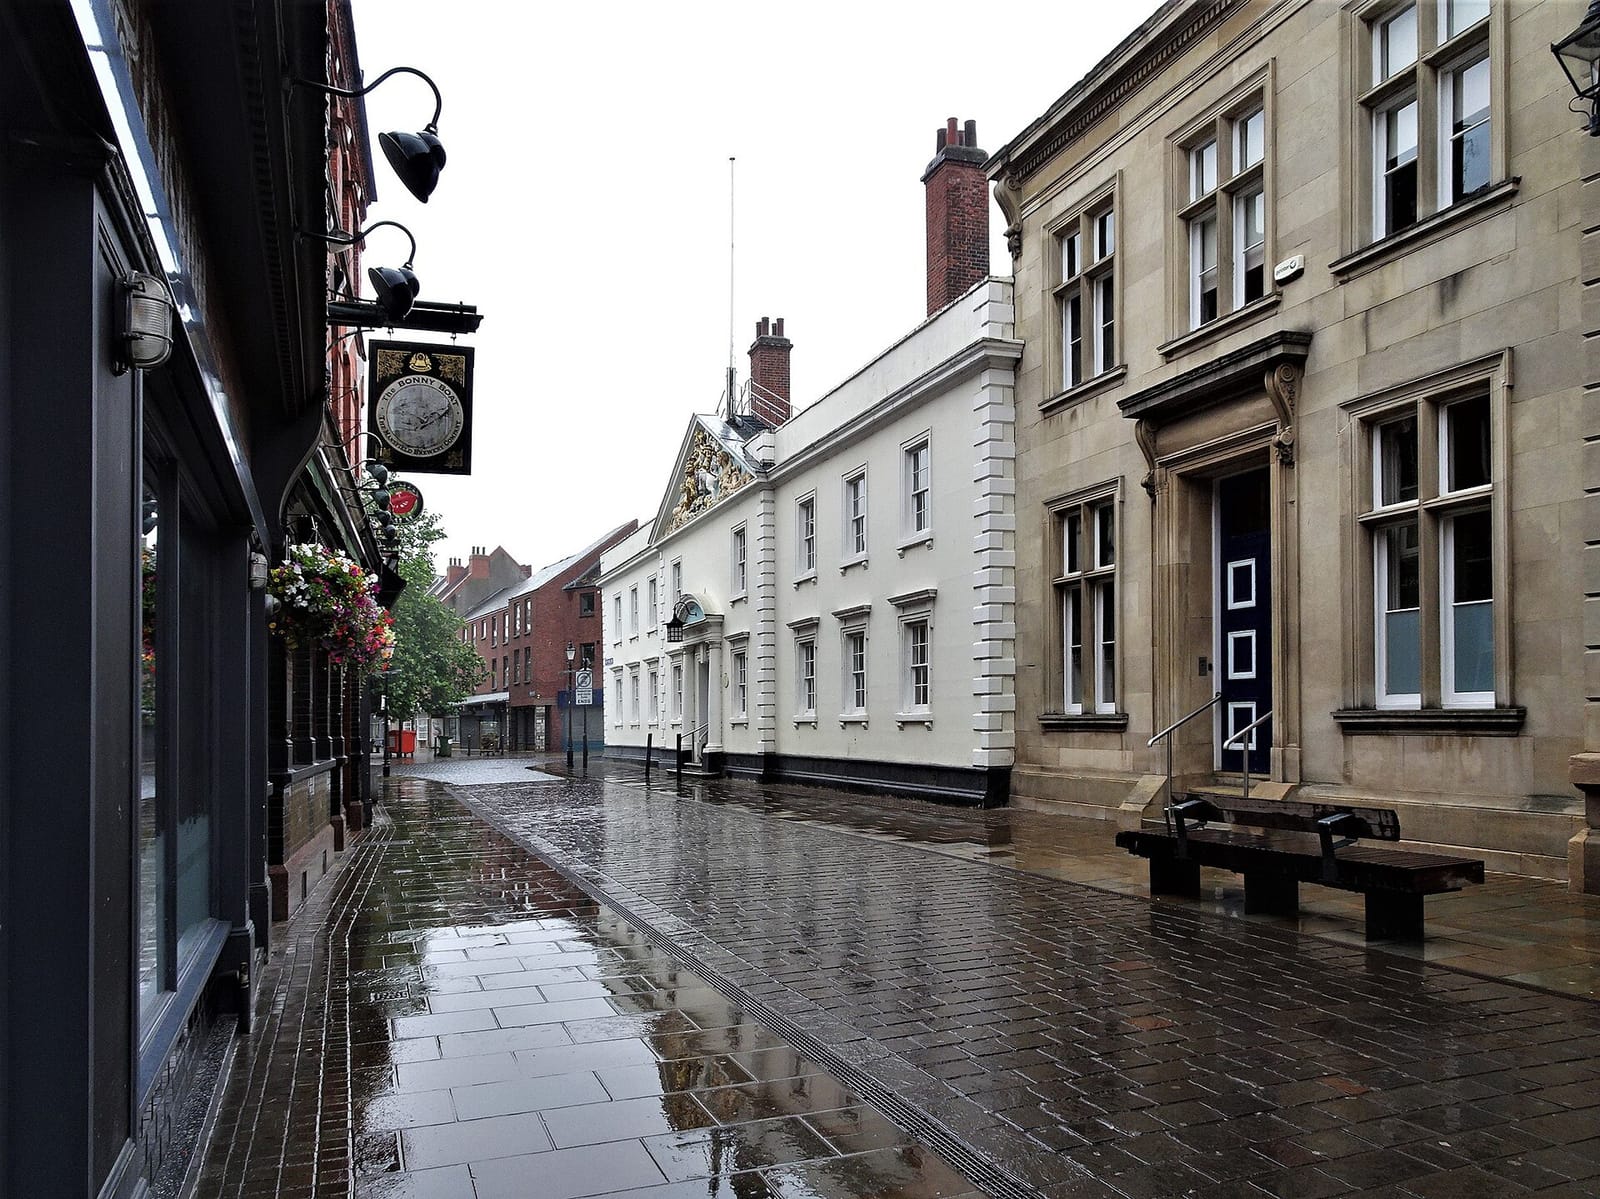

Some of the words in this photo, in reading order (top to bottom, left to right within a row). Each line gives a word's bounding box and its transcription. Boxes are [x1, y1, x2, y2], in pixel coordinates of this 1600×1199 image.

[382, 387, 396, 401] The
[398, 377, 435, 387] BONNY
[438, 384, 459, 406] BOAT
